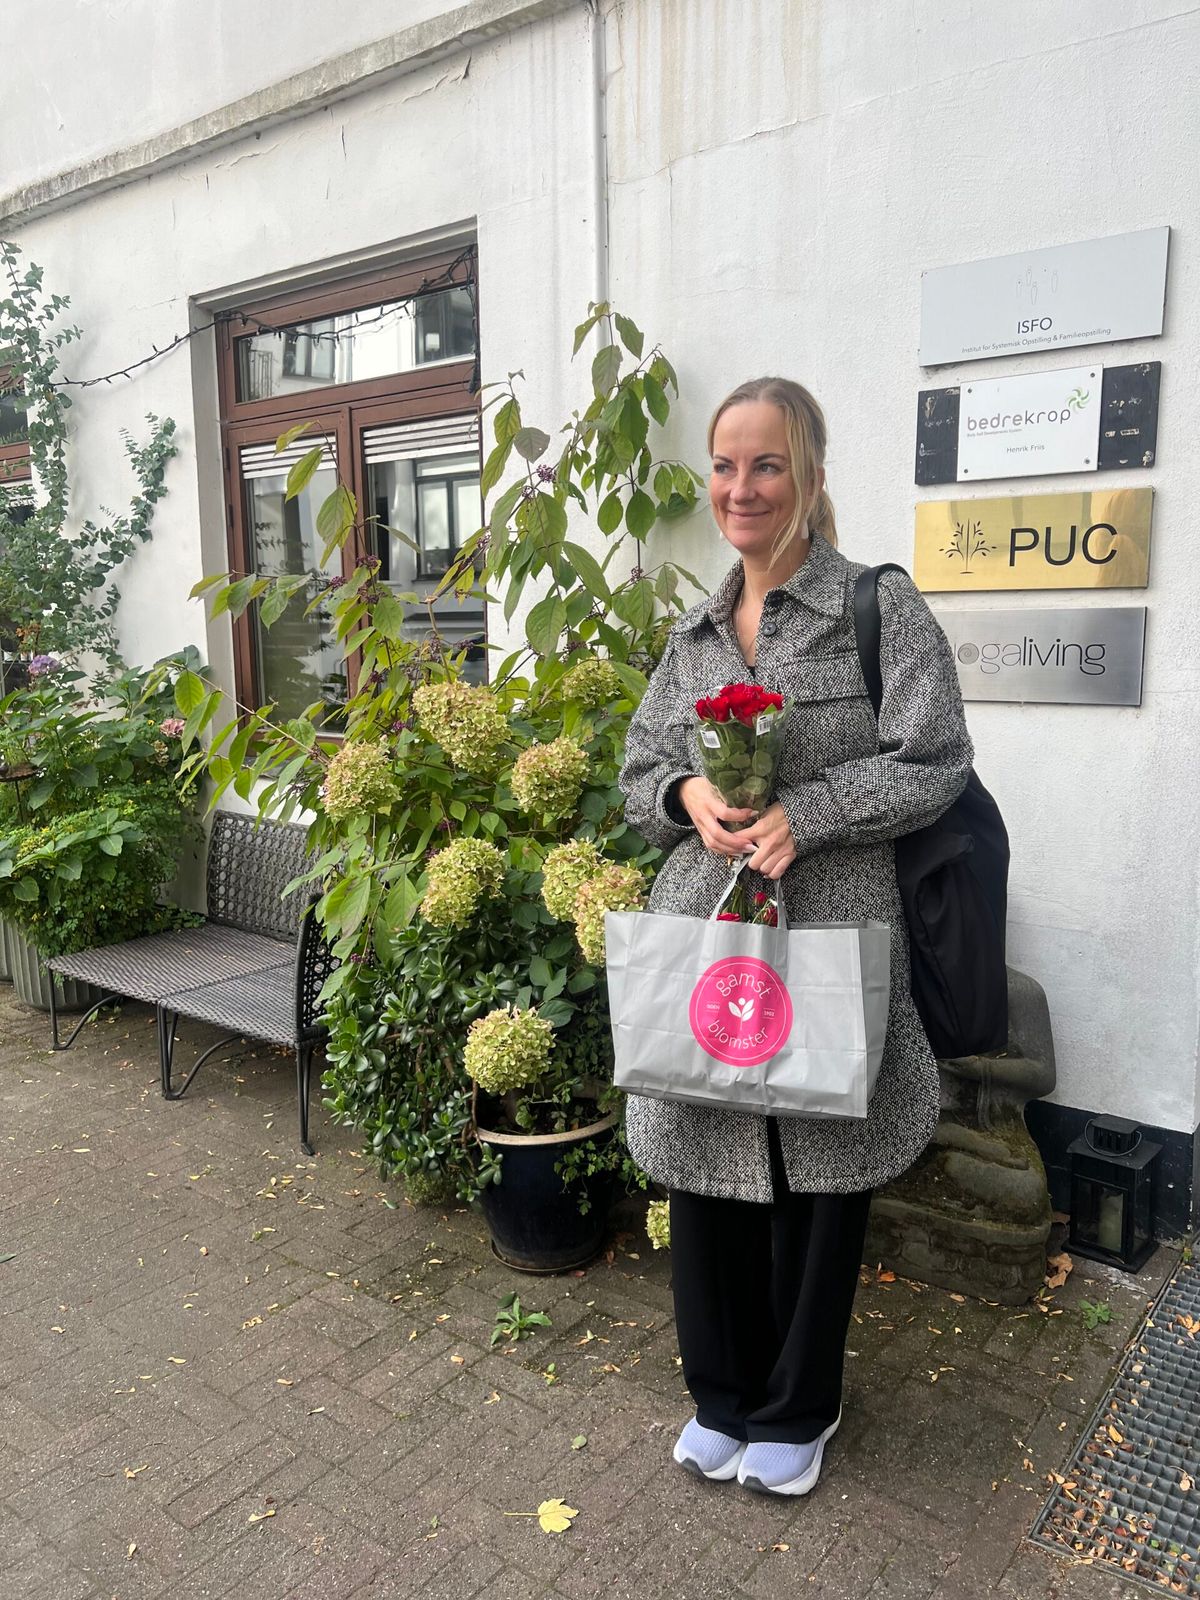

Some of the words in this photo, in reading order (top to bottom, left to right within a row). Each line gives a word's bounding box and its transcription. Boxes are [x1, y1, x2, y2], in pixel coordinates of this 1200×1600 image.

[1017, 316, 1053, 334] ISFO
[992, 341, 1020, 351] Systemisk
[1021, 336, 1052, 346] Opstilling
[967, 408, 1071, 431] bedrekrop
[1006, 445, 1029, 453] Henrik
[1008, 523, 1118, 567] PUC
[953, 636, 1106, 675] ogaliving
[715, 972, 772, 1000] gamst
[707, 1019, 769, 1050] blomster
